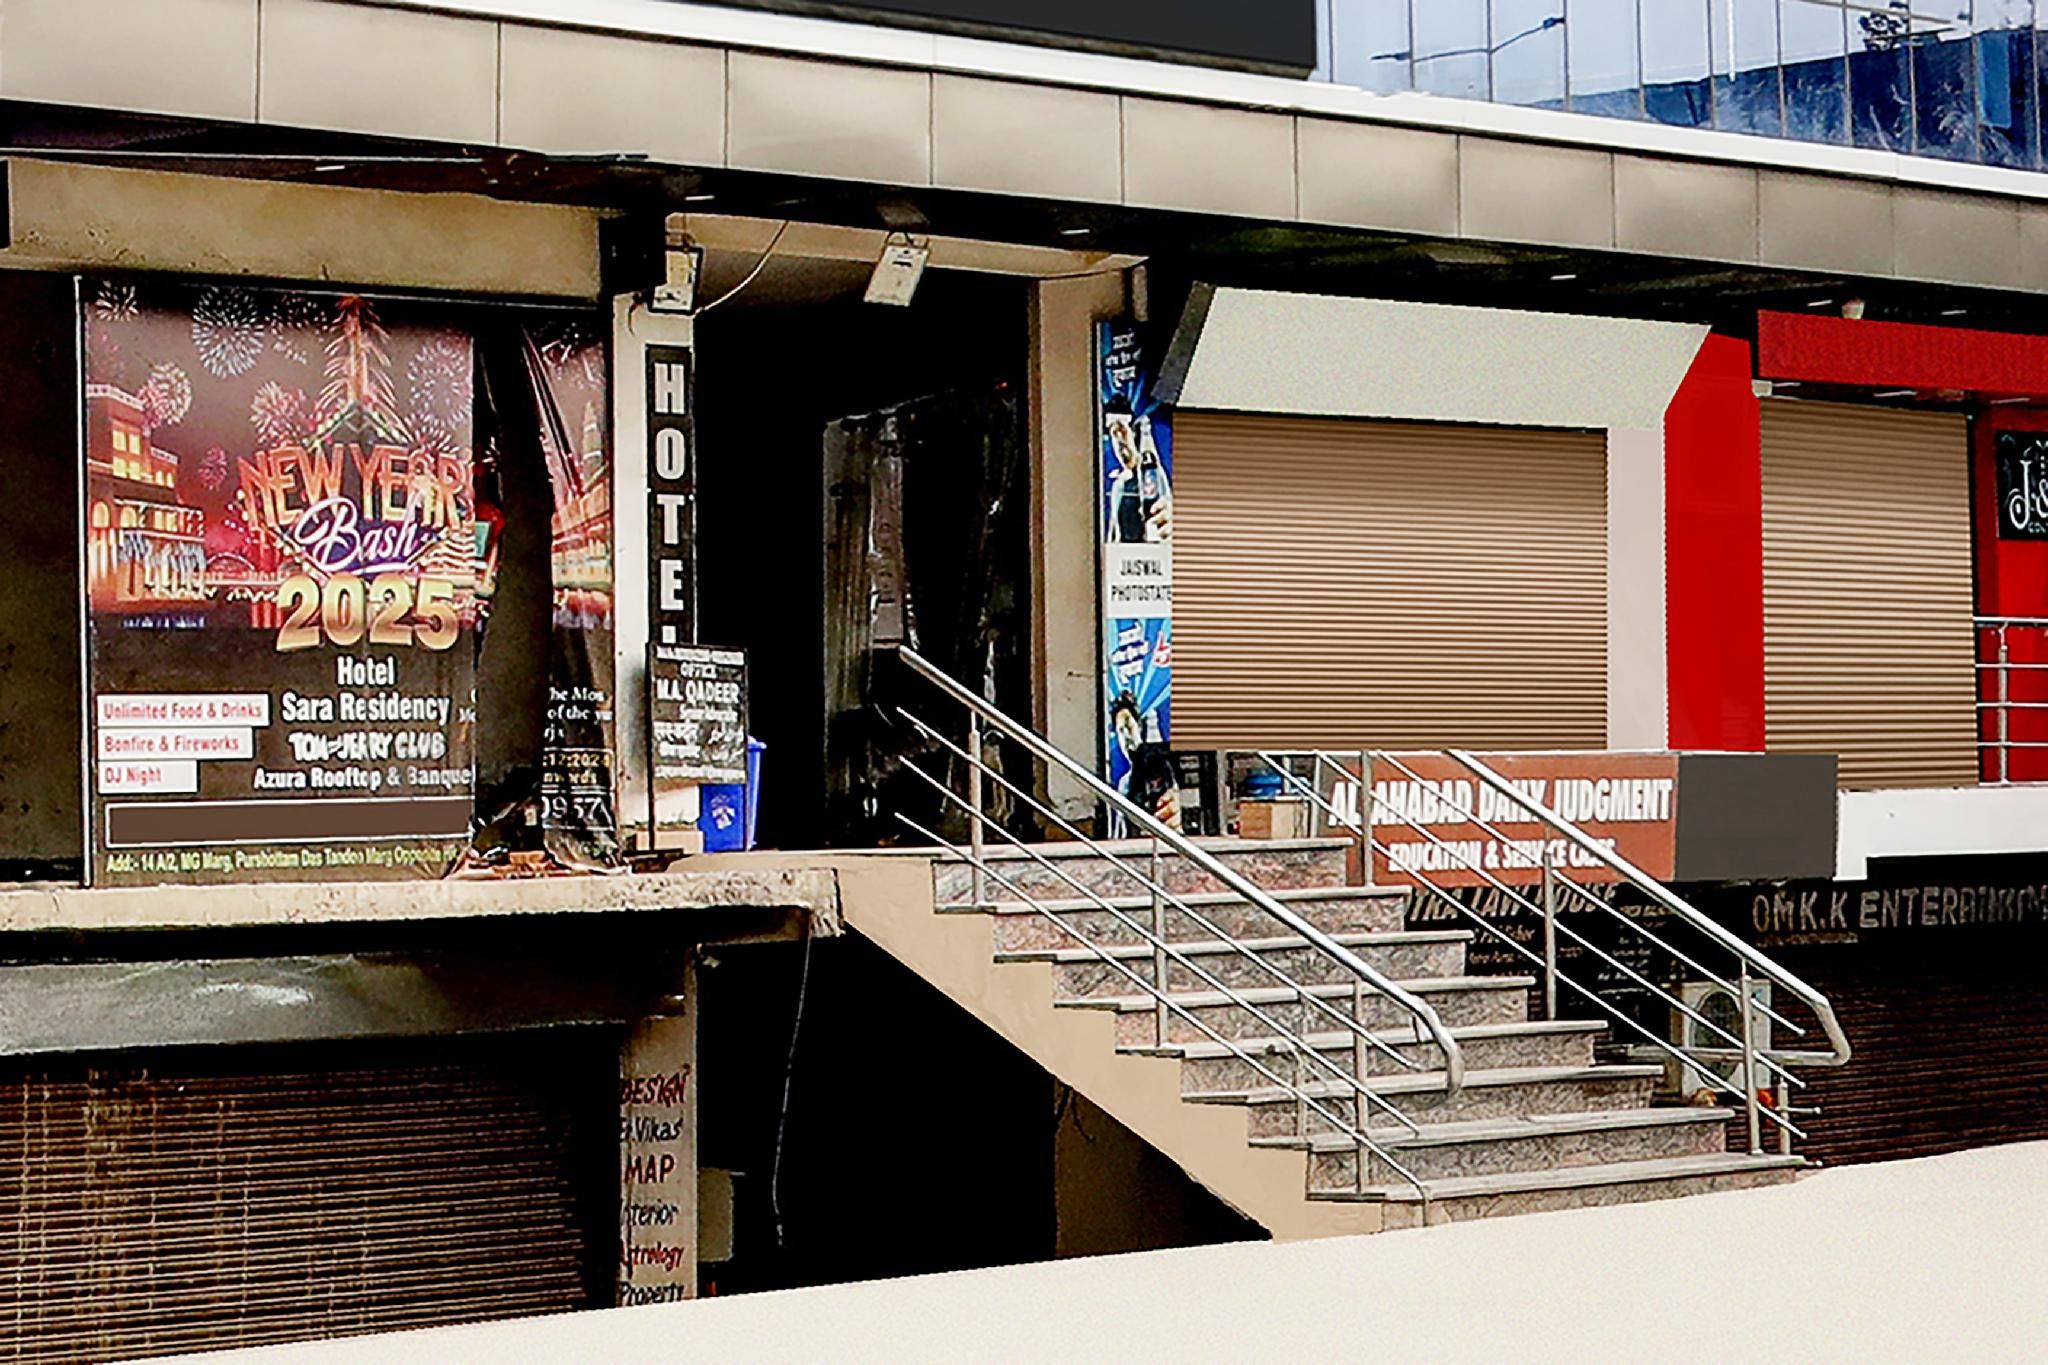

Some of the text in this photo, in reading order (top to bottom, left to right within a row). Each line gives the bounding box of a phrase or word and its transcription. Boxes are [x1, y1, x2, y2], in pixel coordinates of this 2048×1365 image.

[238, 443, 463, 530] NEW YEAR
[654, 363, 686, 643] HOTE
[295, 496, 418, 572] Bash
[1121, 560, 1162, 575] JAISWAL
[276, 572, 460, 651] 2025
[337, 656, 395, 686] Hotel
[104, 703, 262, 719] Unlimited Food & Drinks
[282, 691, 334, 721] Sara
[339, 691, 450, 726] Residency
[105, 735, 239, 751] Bonfire & Fireworks
[395, 732, 446, 759] CLUB
[105, 767, 162, 786] DJ Night
[254, 767, 306, 788] Azura
[310, 767, 381, 791] Rooftop
[387, 767, 400, 785] &
[1328, 778, 1474, 827] ALAHABAD
[1552, 778, 1673, 823] JUDGMENT
[1387, 841, 1482, 872] EDUCATION
[1485, 840, 1500, 868] &
[1502, 838, 1567, 868] SERVCE
[624, 1154, 675, 1184] MAP
[620, 1199, 678, 1226] terior
[619, 1242, 684, 1273] trology
